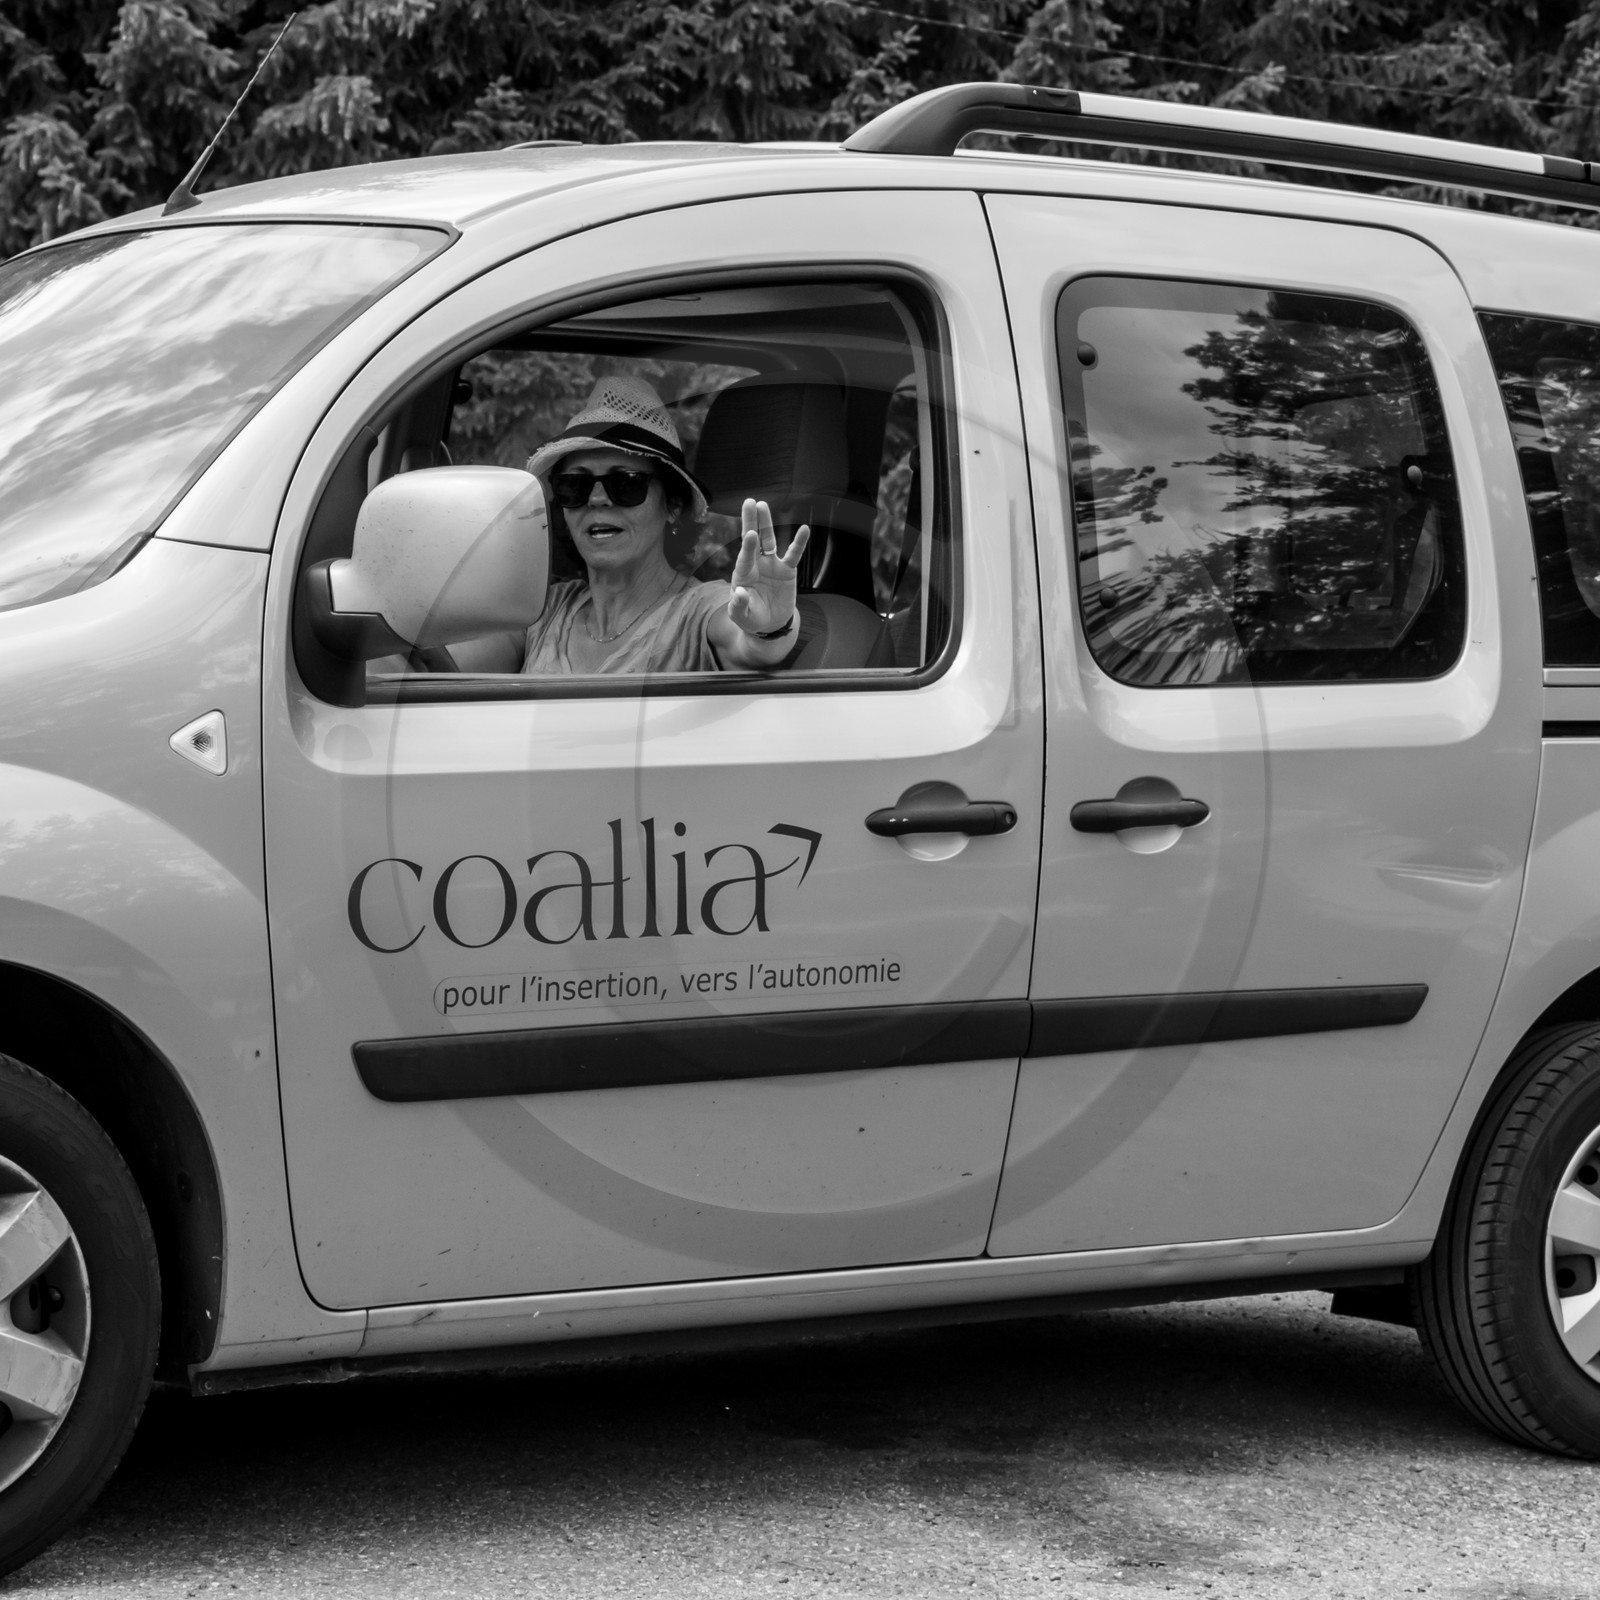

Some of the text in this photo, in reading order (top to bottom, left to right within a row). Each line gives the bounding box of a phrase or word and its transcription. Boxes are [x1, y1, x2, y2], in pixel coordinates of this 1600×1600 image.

[346, 816, 804, 954] coallia
[442, 957, 902, 1014] pour l'insertion, vers l'autonomie
